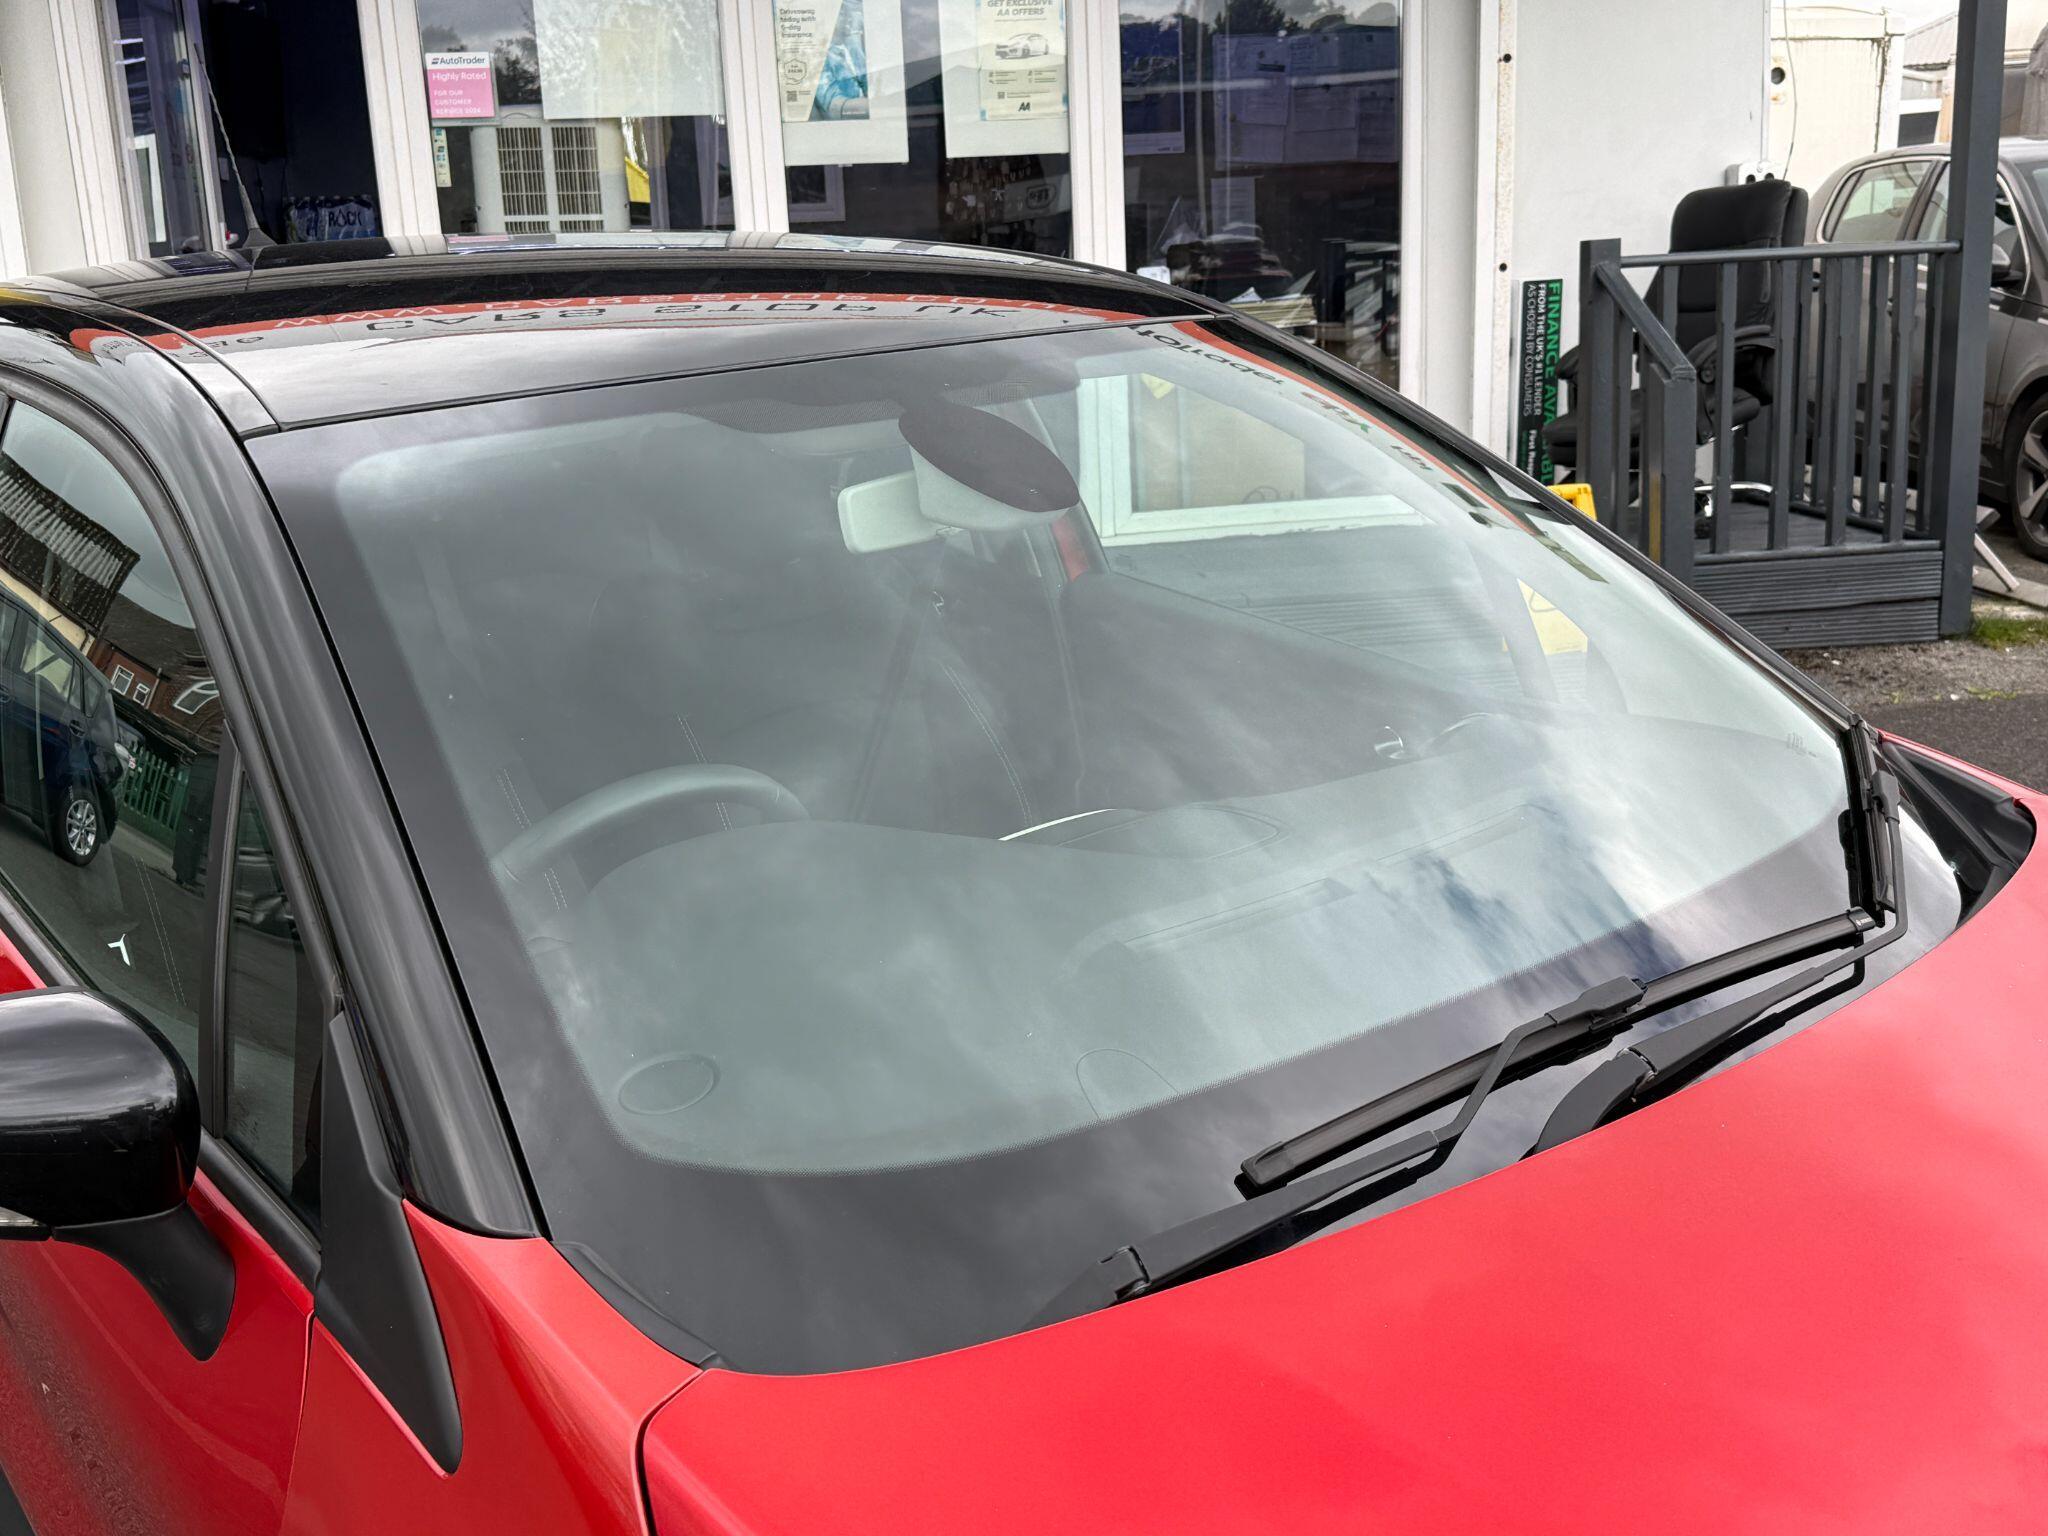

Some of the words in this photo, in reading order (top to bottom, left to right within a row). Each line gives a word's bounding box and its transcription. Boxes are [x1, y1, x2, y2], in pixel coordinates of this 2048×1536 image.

[997, 8, 1010, 16] AA
[1012, 7, 1045, 15] OFFERS
[440, 57, 485, 65] AutoTrader
[432, 72, 459, 82] Highly
[461, 72, 487, 80] Rated
[1018, 102, 1031, 112] AA
[1527, 284, 1537, 298] AS
[1537, 283, 1547, 313] FROM
[1525, 298, 1536, 340] CHOSEN
[1536, 314, 1546, 336] THE
[1545, 282, 1561, 379] FINANCE
[1525, 342, 1535, 355] BY
[1523, 355, 1534, 417] CONSUMERS
[1533, 376, 1543, 416] LENDER
[1529, 429, 1537, 449] First
